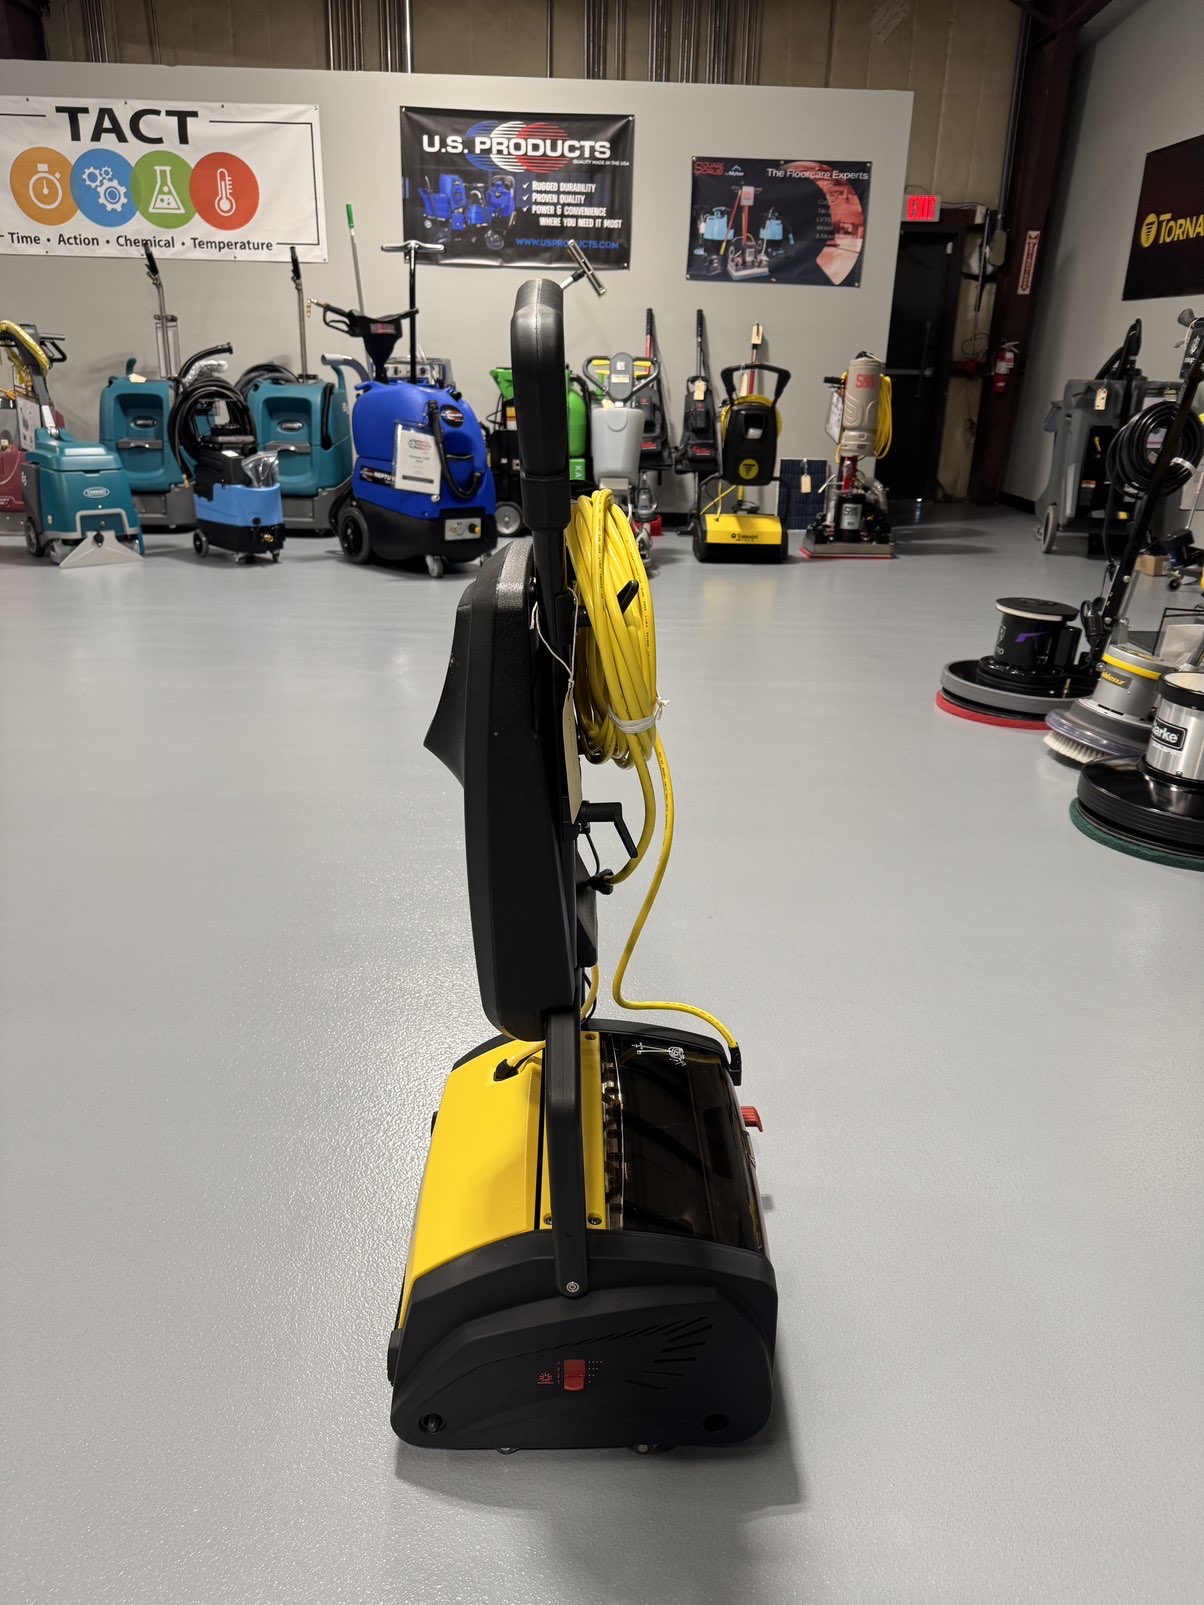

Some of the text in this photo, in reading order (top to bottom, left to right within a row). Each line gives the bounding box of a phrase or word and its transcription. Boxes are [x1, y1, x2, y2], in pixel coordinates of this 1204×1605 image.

[55, 106, 199, 145] TACT
[422, 135, 611, 159] U.S. PRODUCTS
[766, 168, 869, 181] The Floorcare Experts
[531, 180, 596, 193] RUGGED DURABILITY
[531, 193, 586, 204] PROVEN QUALITY
[531, 205, 555, 215] POWER
[563, 206, 607, 217] CONVENIENCE
[908, 196, 936, 219] EXIT
[539, 217, 623, 229] WHERE YOU NEED IT MOST
[8, 232, 273, 253] Time Action Chemical Temperature
[515, 238, 619, 249] WWW.USPROUCTS.COM
